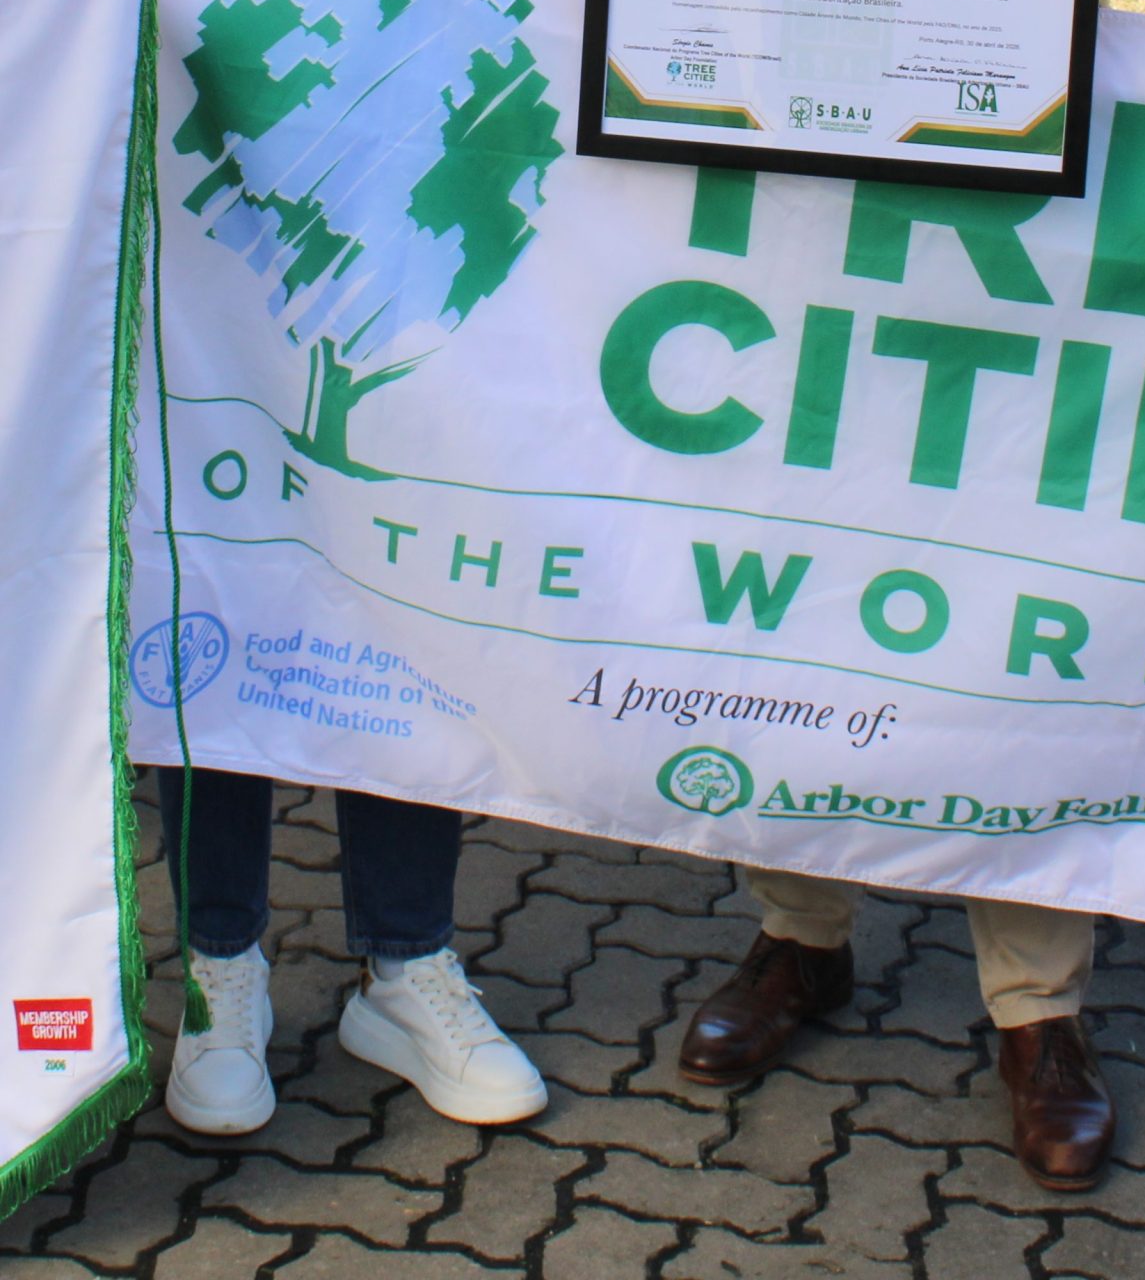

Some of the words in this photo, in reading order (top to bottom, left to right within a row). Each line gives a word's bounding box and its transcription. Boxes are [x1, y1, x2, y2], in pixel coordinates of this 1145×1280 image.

[683, 72, 716, 82] CITIES
[685, 63, 717, 74] TREE
[956, 82, 998, 113] ISA
[203, 450, 309, 502] OF
[372, 516, 584, 599] THE
[245, 629, 303, 655] Food
[310, 636, 352, 664] and
[237, 681, 314, 719] United
[317, 703, 413, 738] Nations
[568, 668, 605, 707] A
[612, 677, 832, 732] programme
[846, 702, 899, 749] of:
[760, 777, 924, 822] Arbor
[936, 794, 1049, 834] Day
[19, 1010, 89, 1026] MEMBERSHIP
[32, 1024, 77, 1039] GROWTH
